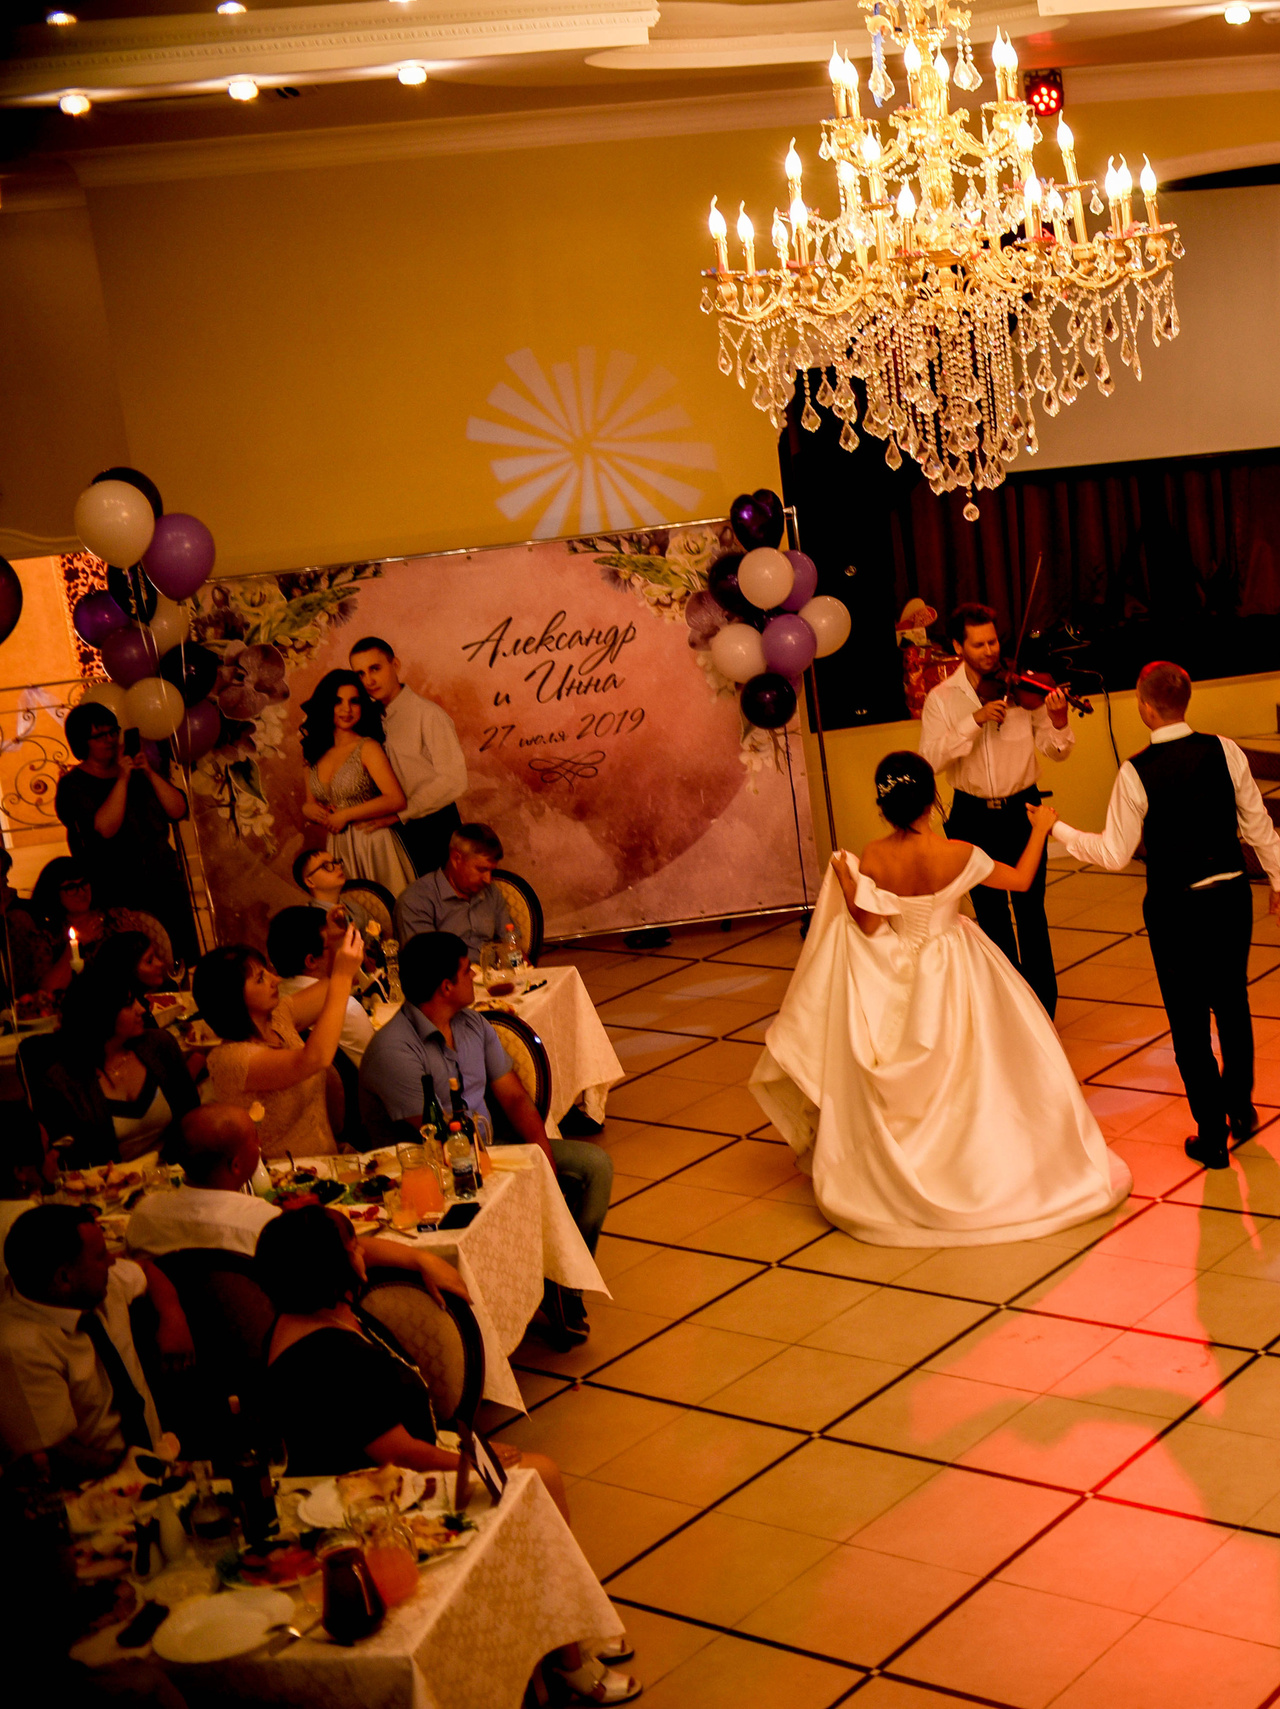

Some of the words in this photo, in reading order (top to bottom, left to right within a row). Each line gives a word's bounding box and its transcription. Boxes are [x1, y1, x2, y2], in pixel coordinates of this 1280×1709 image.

[462, 610, 636, 675] Александр
[493, 690, 511, 707] и
[524, 659, 626, 704] Инна
[478, 724, 516, 752] 27
[518, 731, 566, 747] июля
[576, 707, 645, 740] 2019
